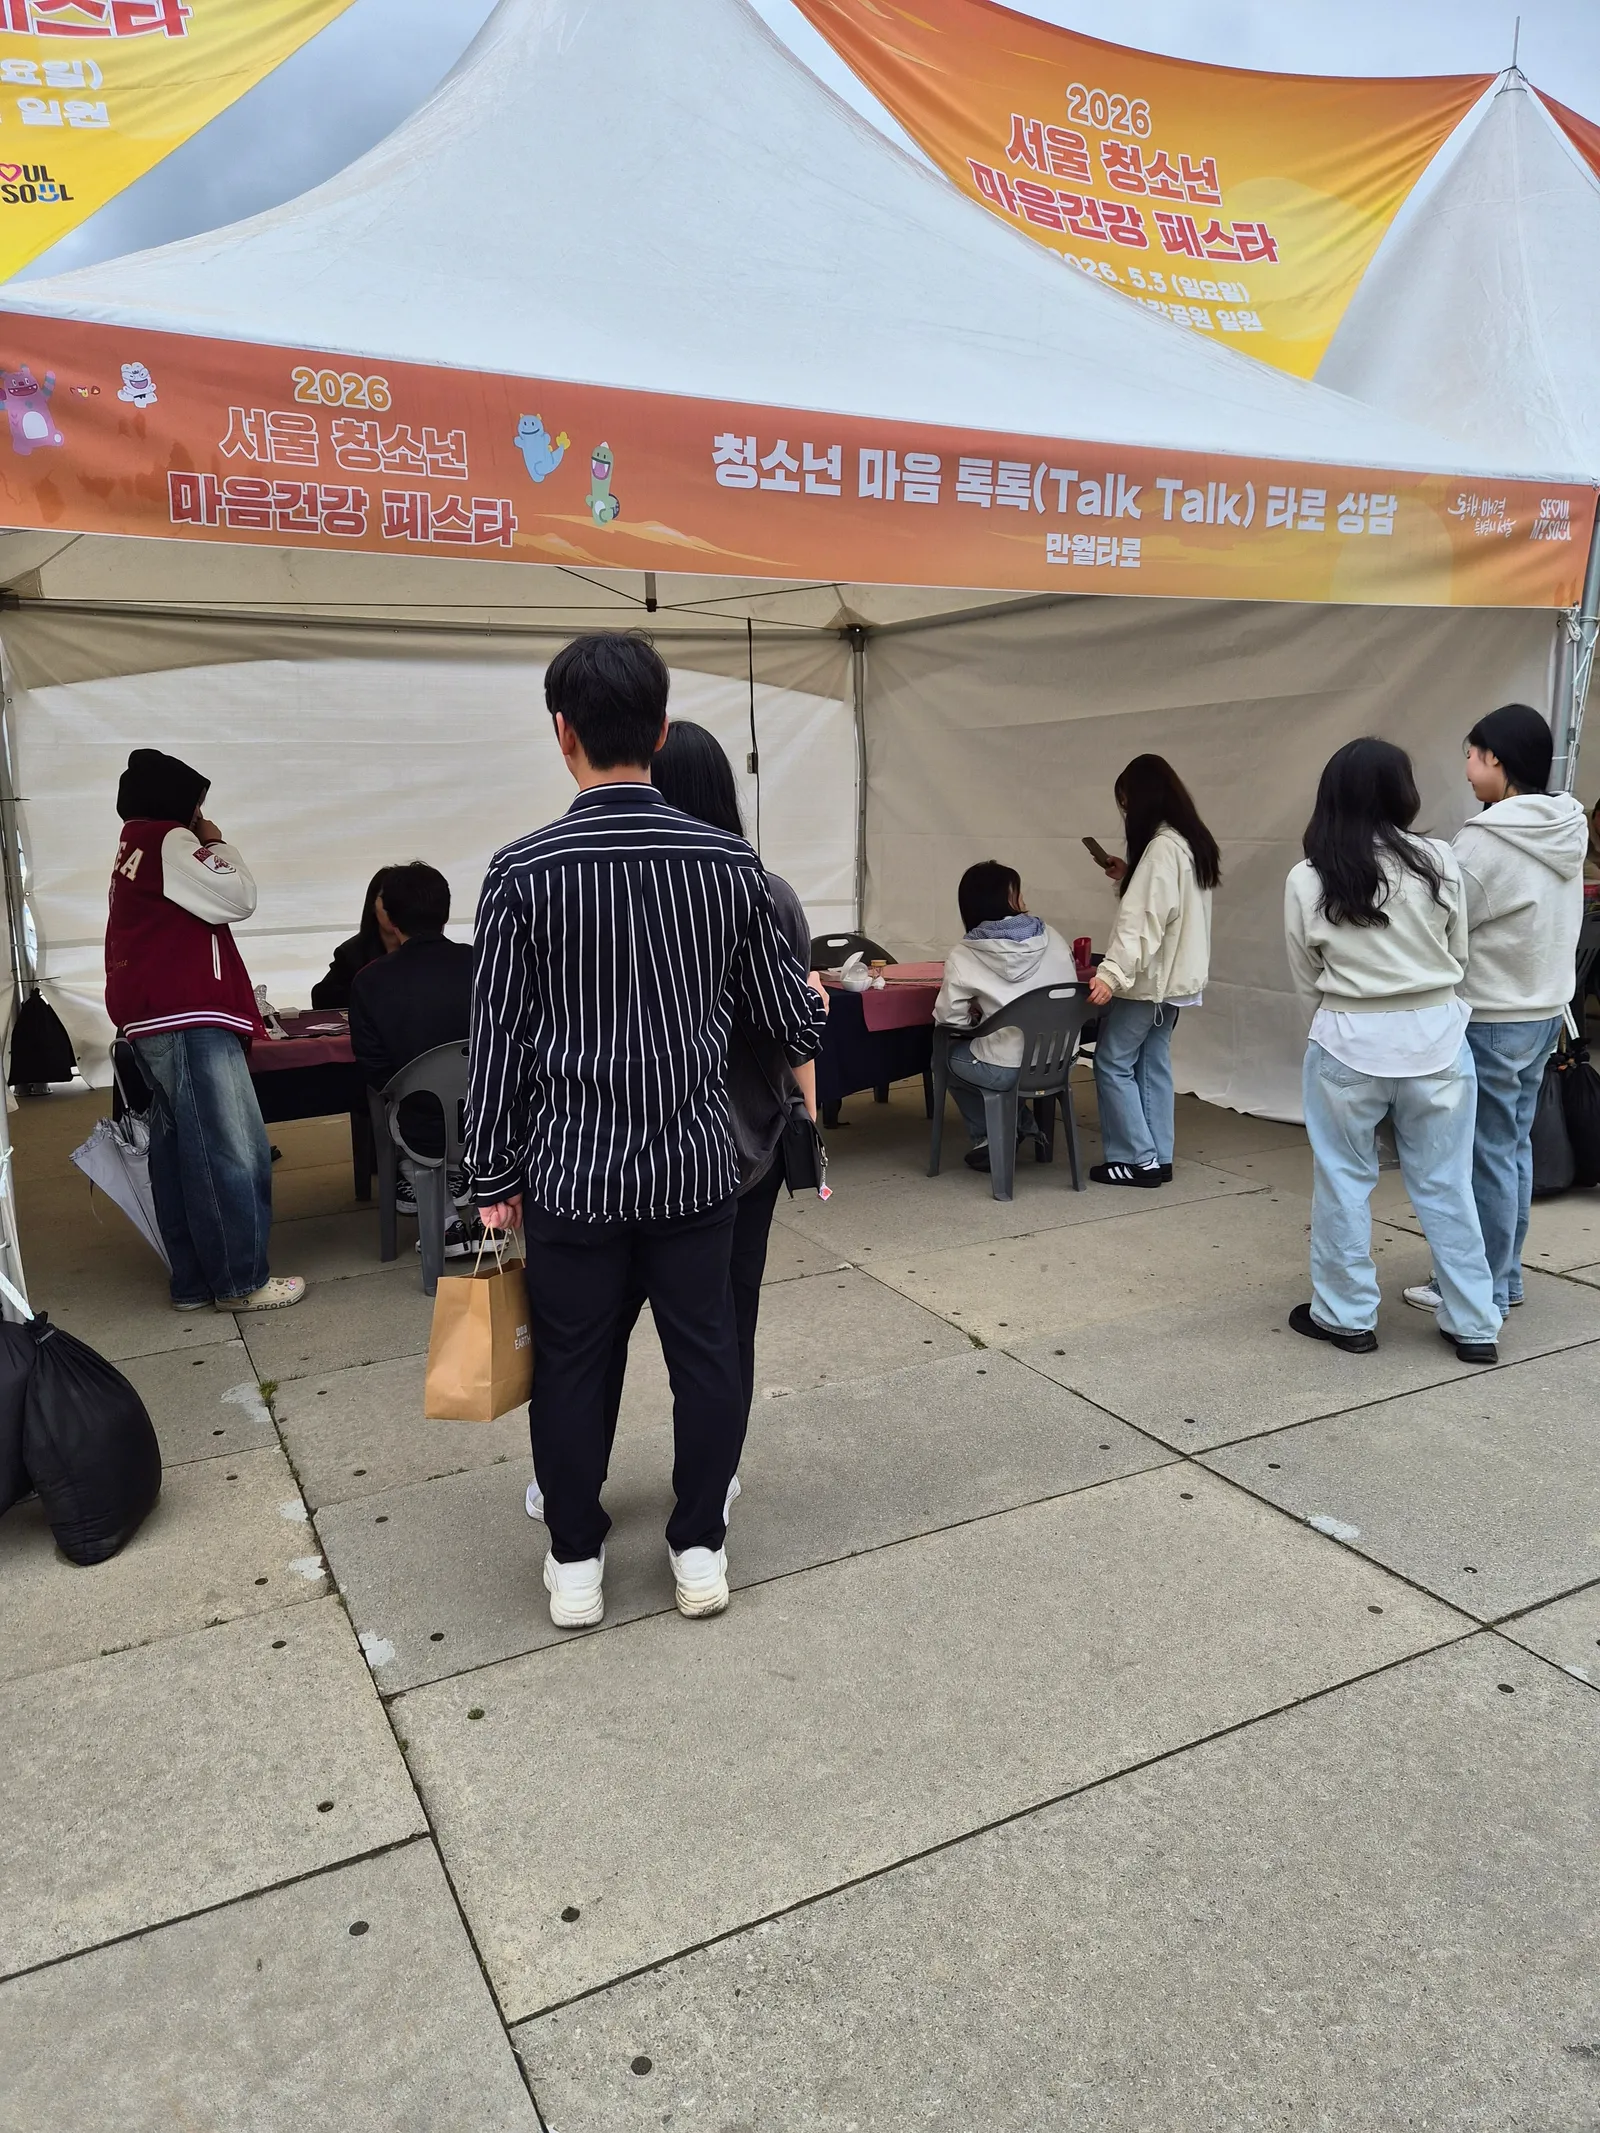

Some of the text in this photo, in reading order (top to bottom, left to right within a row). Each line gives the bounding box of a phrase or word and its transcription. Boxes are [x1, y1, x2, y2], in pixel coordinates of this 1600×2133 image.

[17, 97, 111, 128] 일원
[1067, 83, 1151, 138] 2026
[1005, 114, 1223, 207] 서울 청소년
[966, 157, 1280, 265] 마음건강 페스타
[1216, 309, 1264, 332] 일원
[292, 367, 391, 411] 2026
[219, 406, 468, 480] 서울 청소년
[167, 471, 517, 547] 마음건강 페스타
[711, 432, 1398, 536] 청소년 마음 톡톡(Talk Talk) 타로 상담
[1046, 532, 1141, 568] 만월타로
[1546, 520, 1572, 541] SOUL
